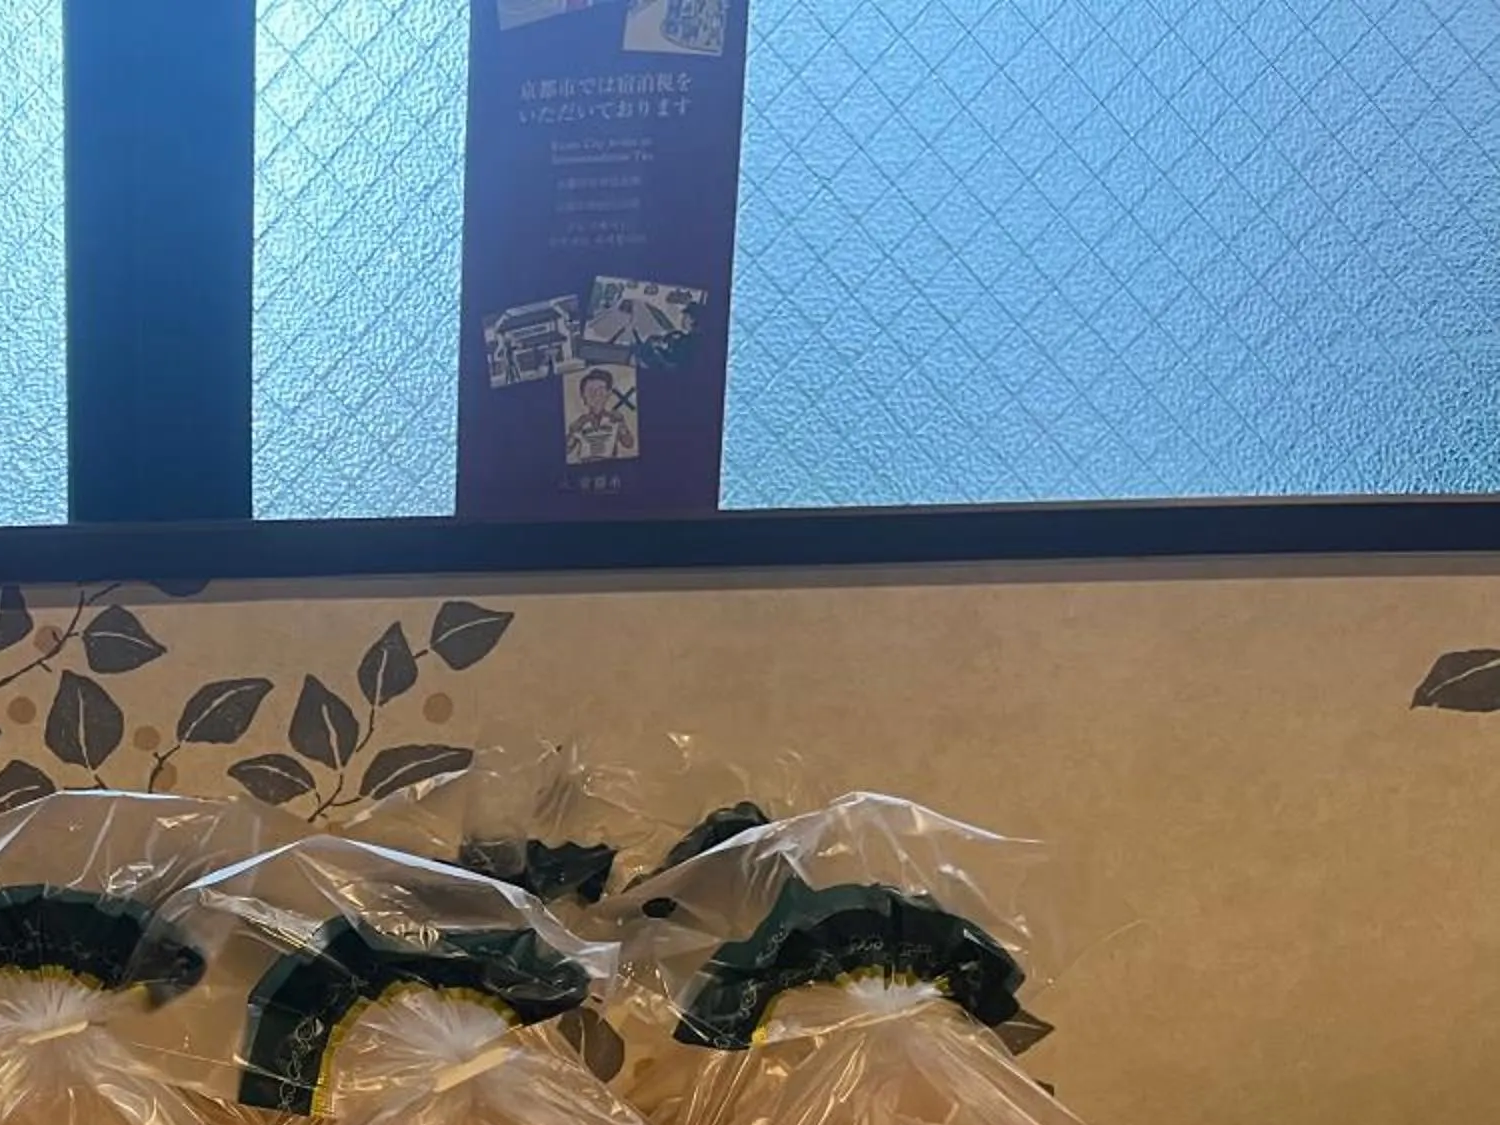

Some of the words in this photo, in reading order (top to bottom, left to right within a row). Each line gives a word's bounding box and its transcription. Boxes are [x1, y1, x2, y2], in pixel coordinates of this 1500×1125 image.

[518, 98, 692, 123] いただいております
